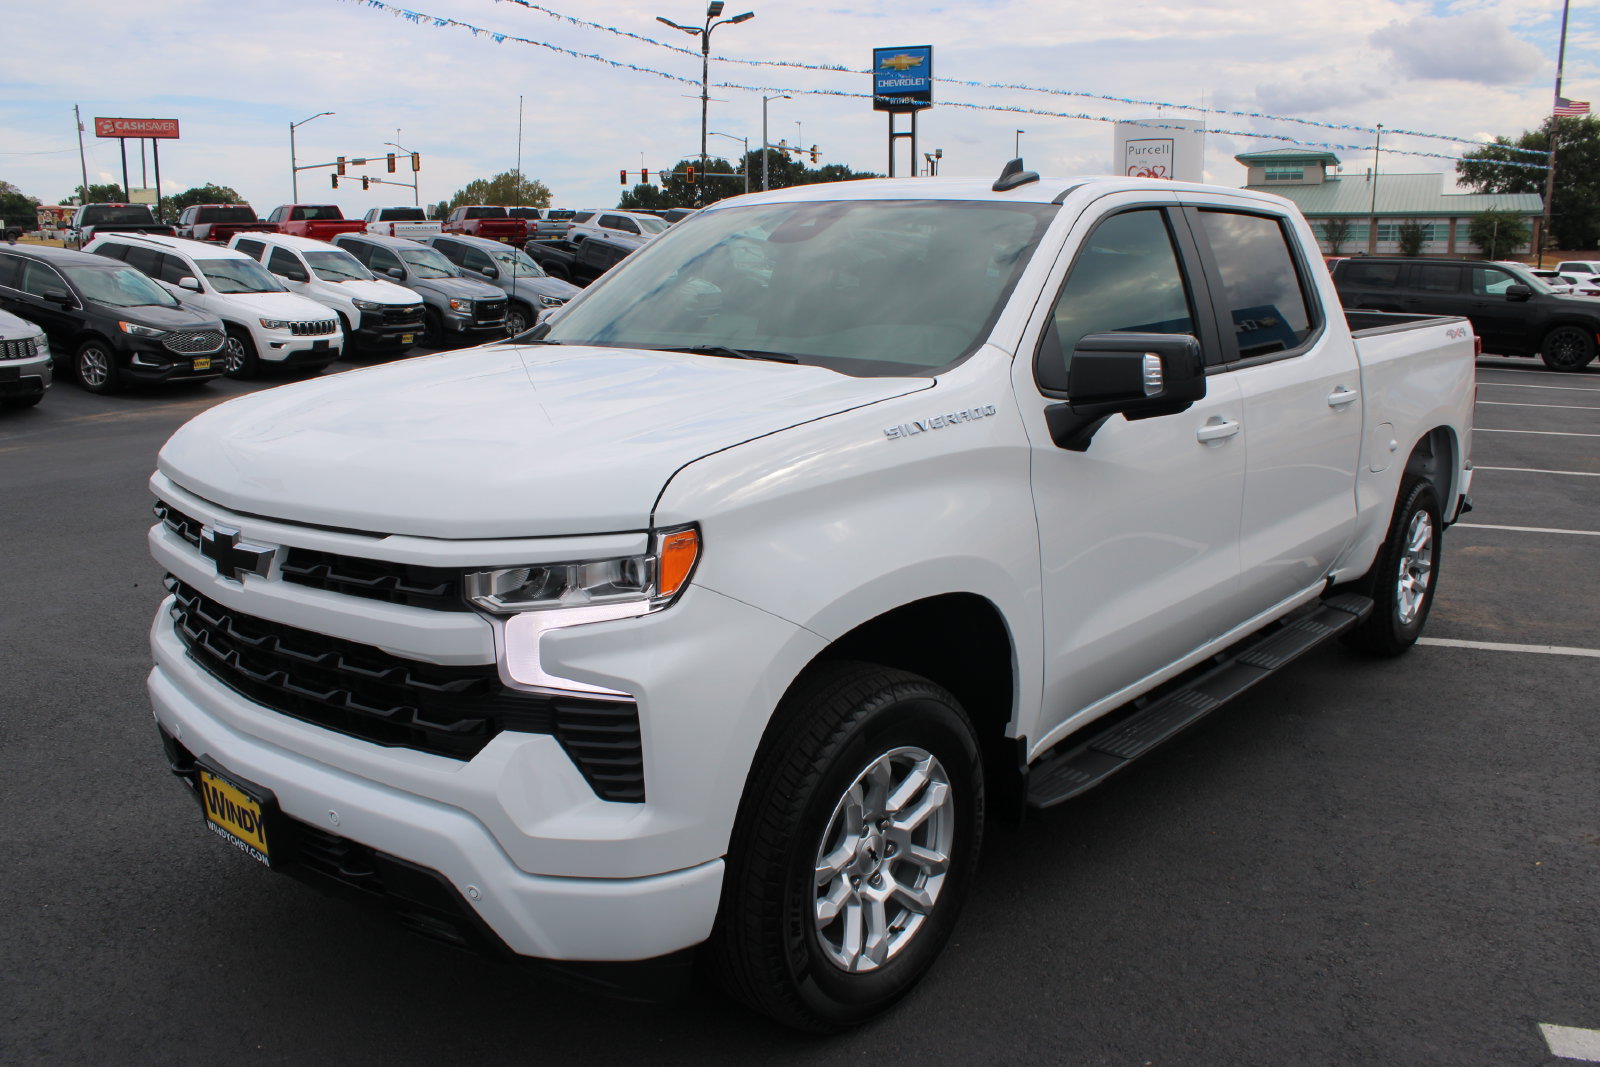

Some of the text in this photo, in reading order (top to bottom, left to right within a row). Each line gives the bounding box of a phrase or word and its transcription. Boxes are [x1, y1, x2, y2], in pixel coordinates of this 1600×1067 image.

[878, 78, 925, 87] CHEVROLET
[115, 121, 176, 131] CASHSAVER
[1128, 144, 1169, 155] Purcell
[883, 405, 997, 441] SILVERADO
[202, 781, 265, 844] WINDY
[207, 820, 270, 867] WINDYCHEV.COM
